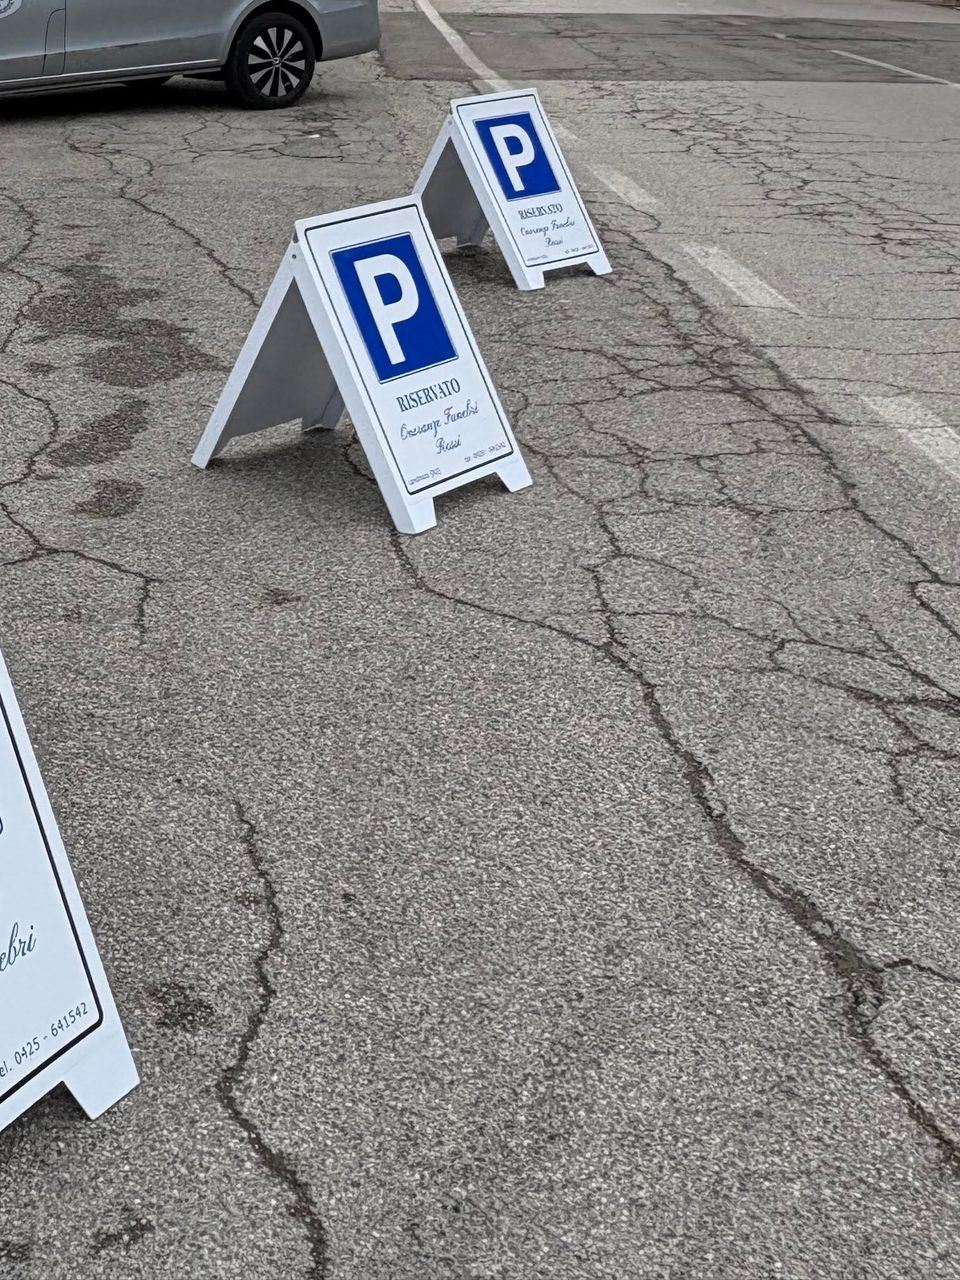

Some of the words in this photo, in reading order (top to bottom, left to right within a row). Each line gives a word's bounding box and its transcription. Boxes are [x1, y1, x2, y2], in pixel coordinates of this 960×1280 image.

[489, 123, 535, 192] P
[353, 253, 419, 365] P
[396, 378, 461, 412] RISERVATO
[14, 1036, 40, 1065] 0425
[50, 1001, 89, 1038] 641542
